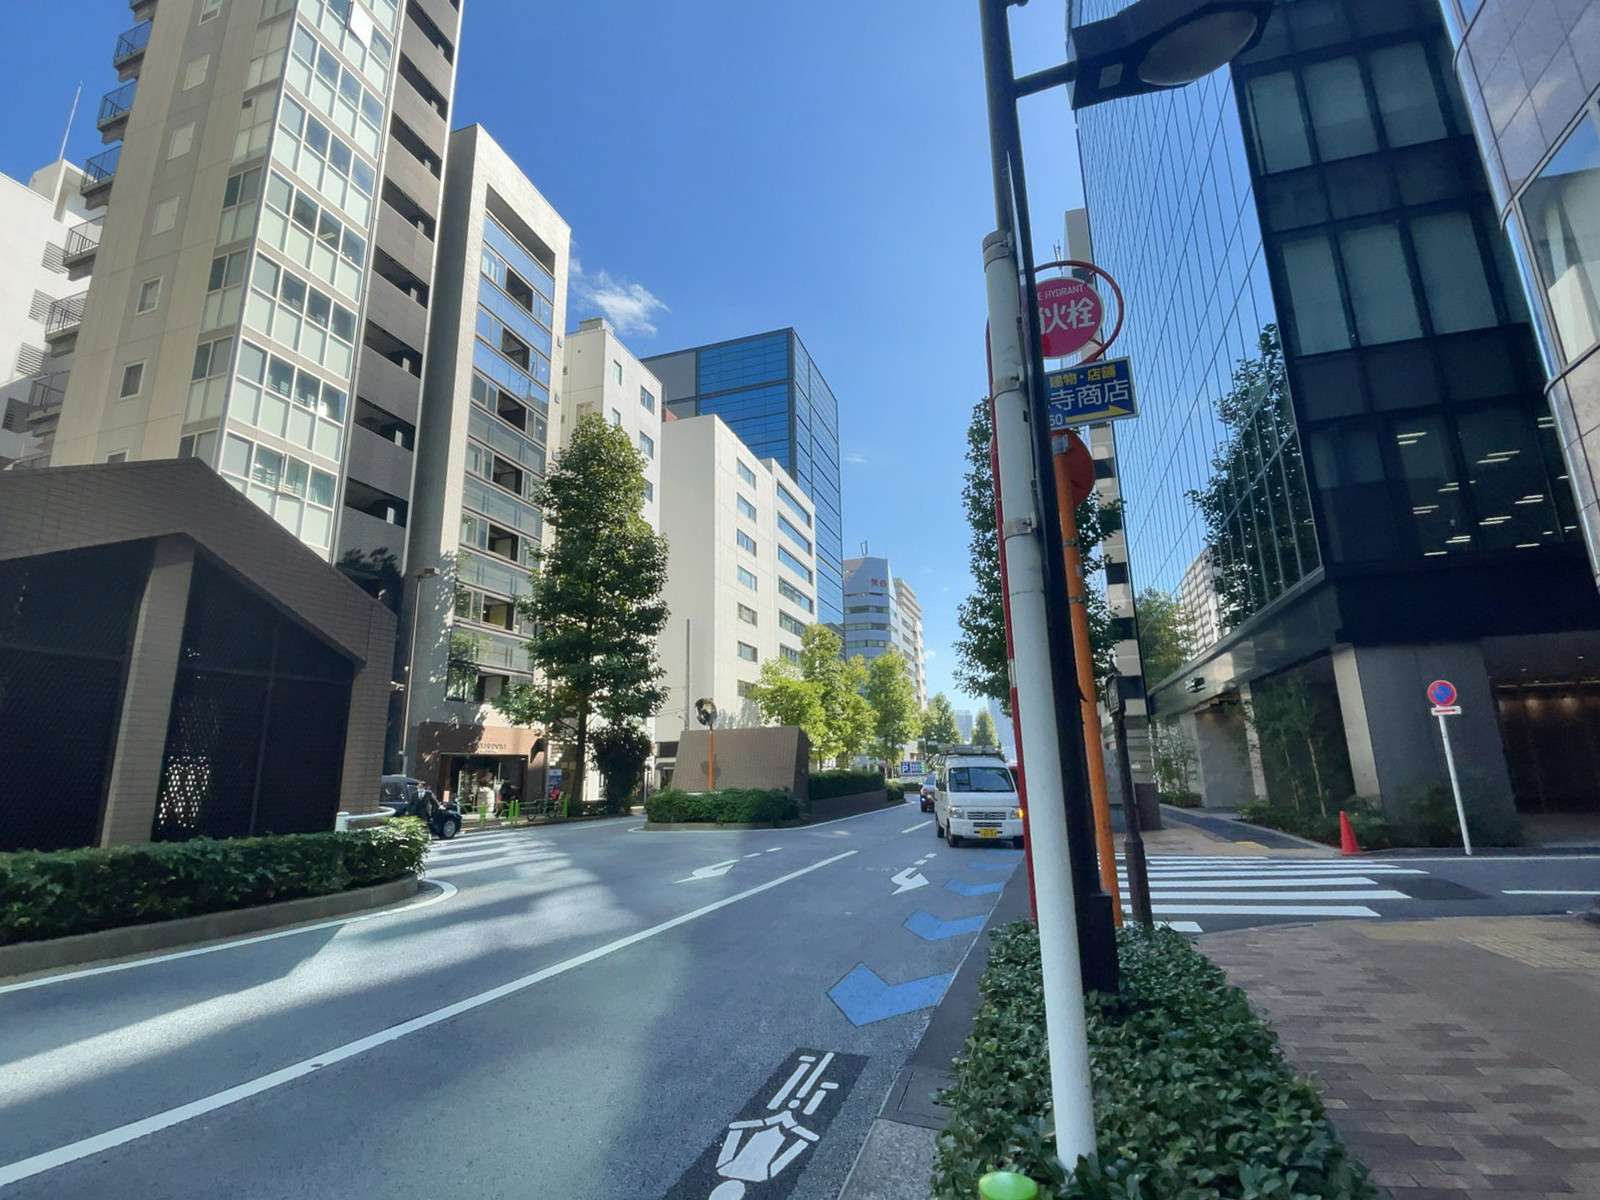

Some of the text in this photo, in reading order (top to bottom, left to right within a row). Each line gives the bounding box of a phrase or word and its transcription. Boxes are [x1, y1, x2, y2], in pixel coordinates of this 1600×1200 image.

[1045, 284, 1084, 299] HYDRANT
[1048, 379, 1130, 411] 寺商店
